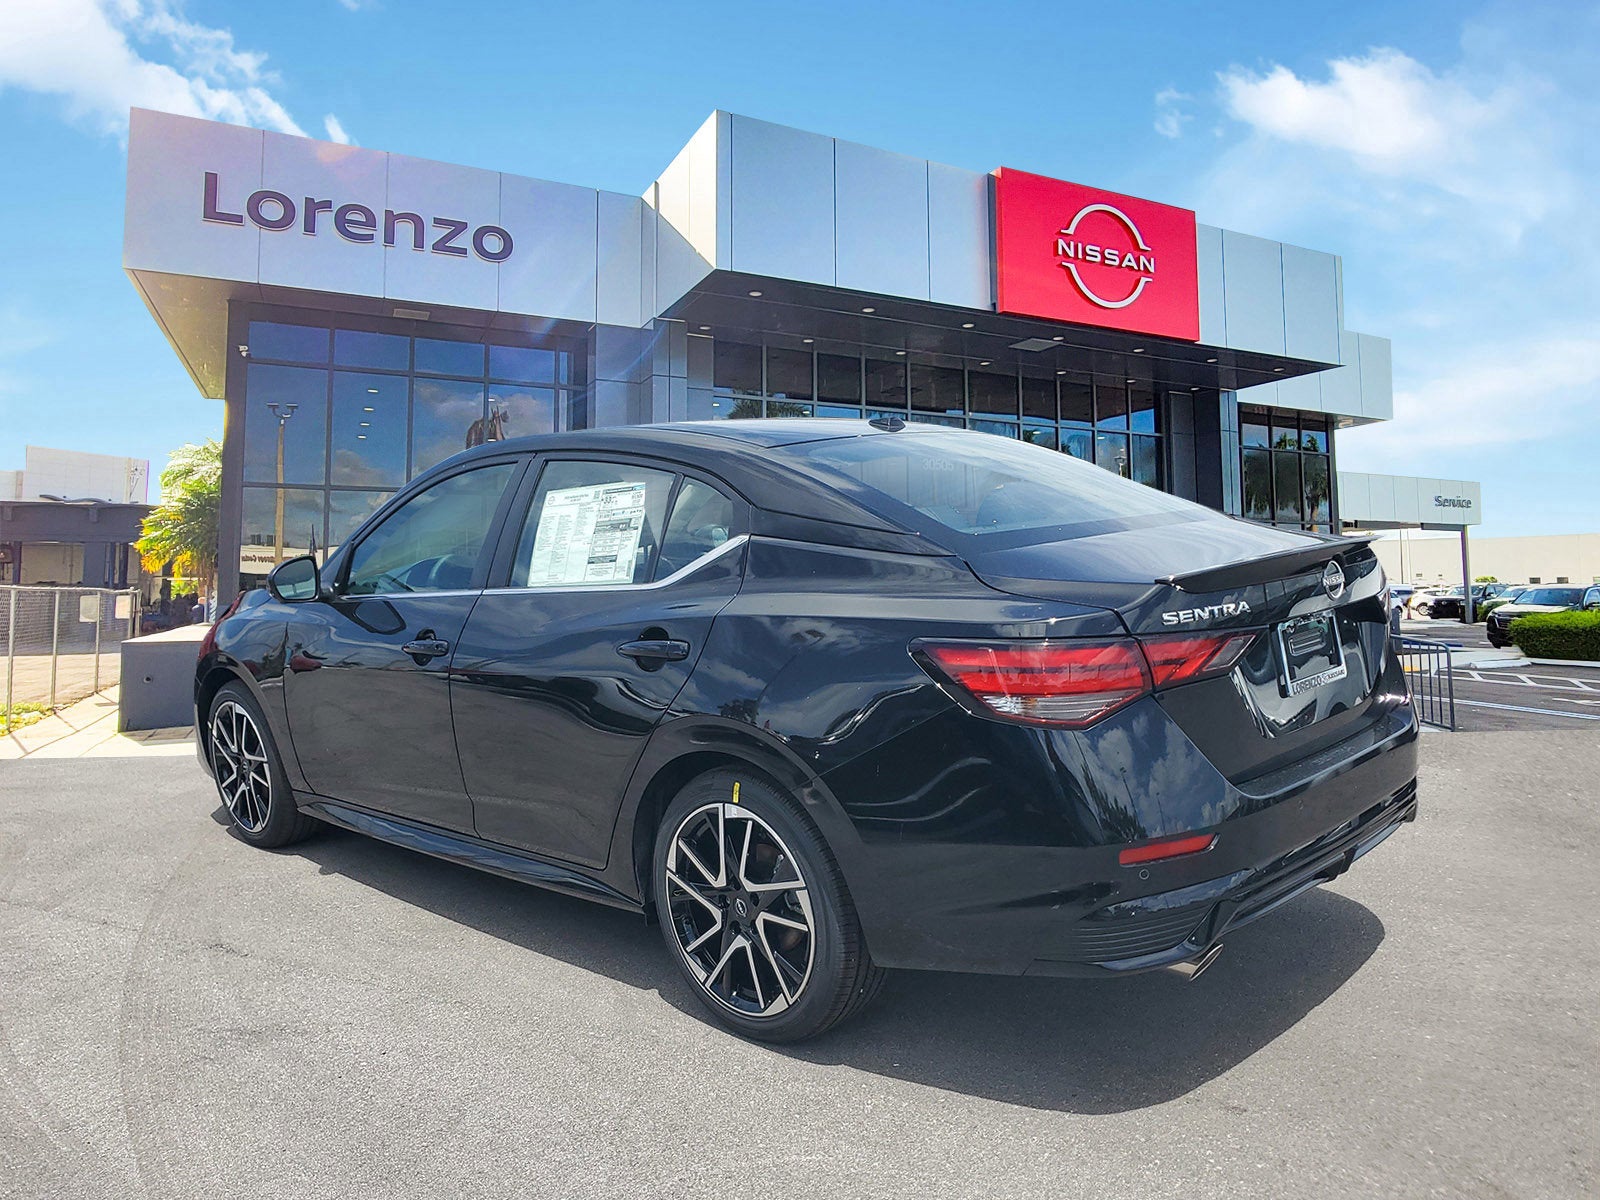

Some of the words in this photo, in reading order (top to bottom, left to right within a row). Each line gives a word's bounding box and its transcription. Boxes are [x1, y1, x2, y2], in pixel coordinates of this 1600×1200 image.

[202, 171, 514, 262] Lorenzo
[1057, 238, 1155, 273] NISSAN
[1434, 495, 1472, 508] Service
[1162, 600, 1252, 626] SENTRA
[1292, 675, 1322, 695] LORENZO
